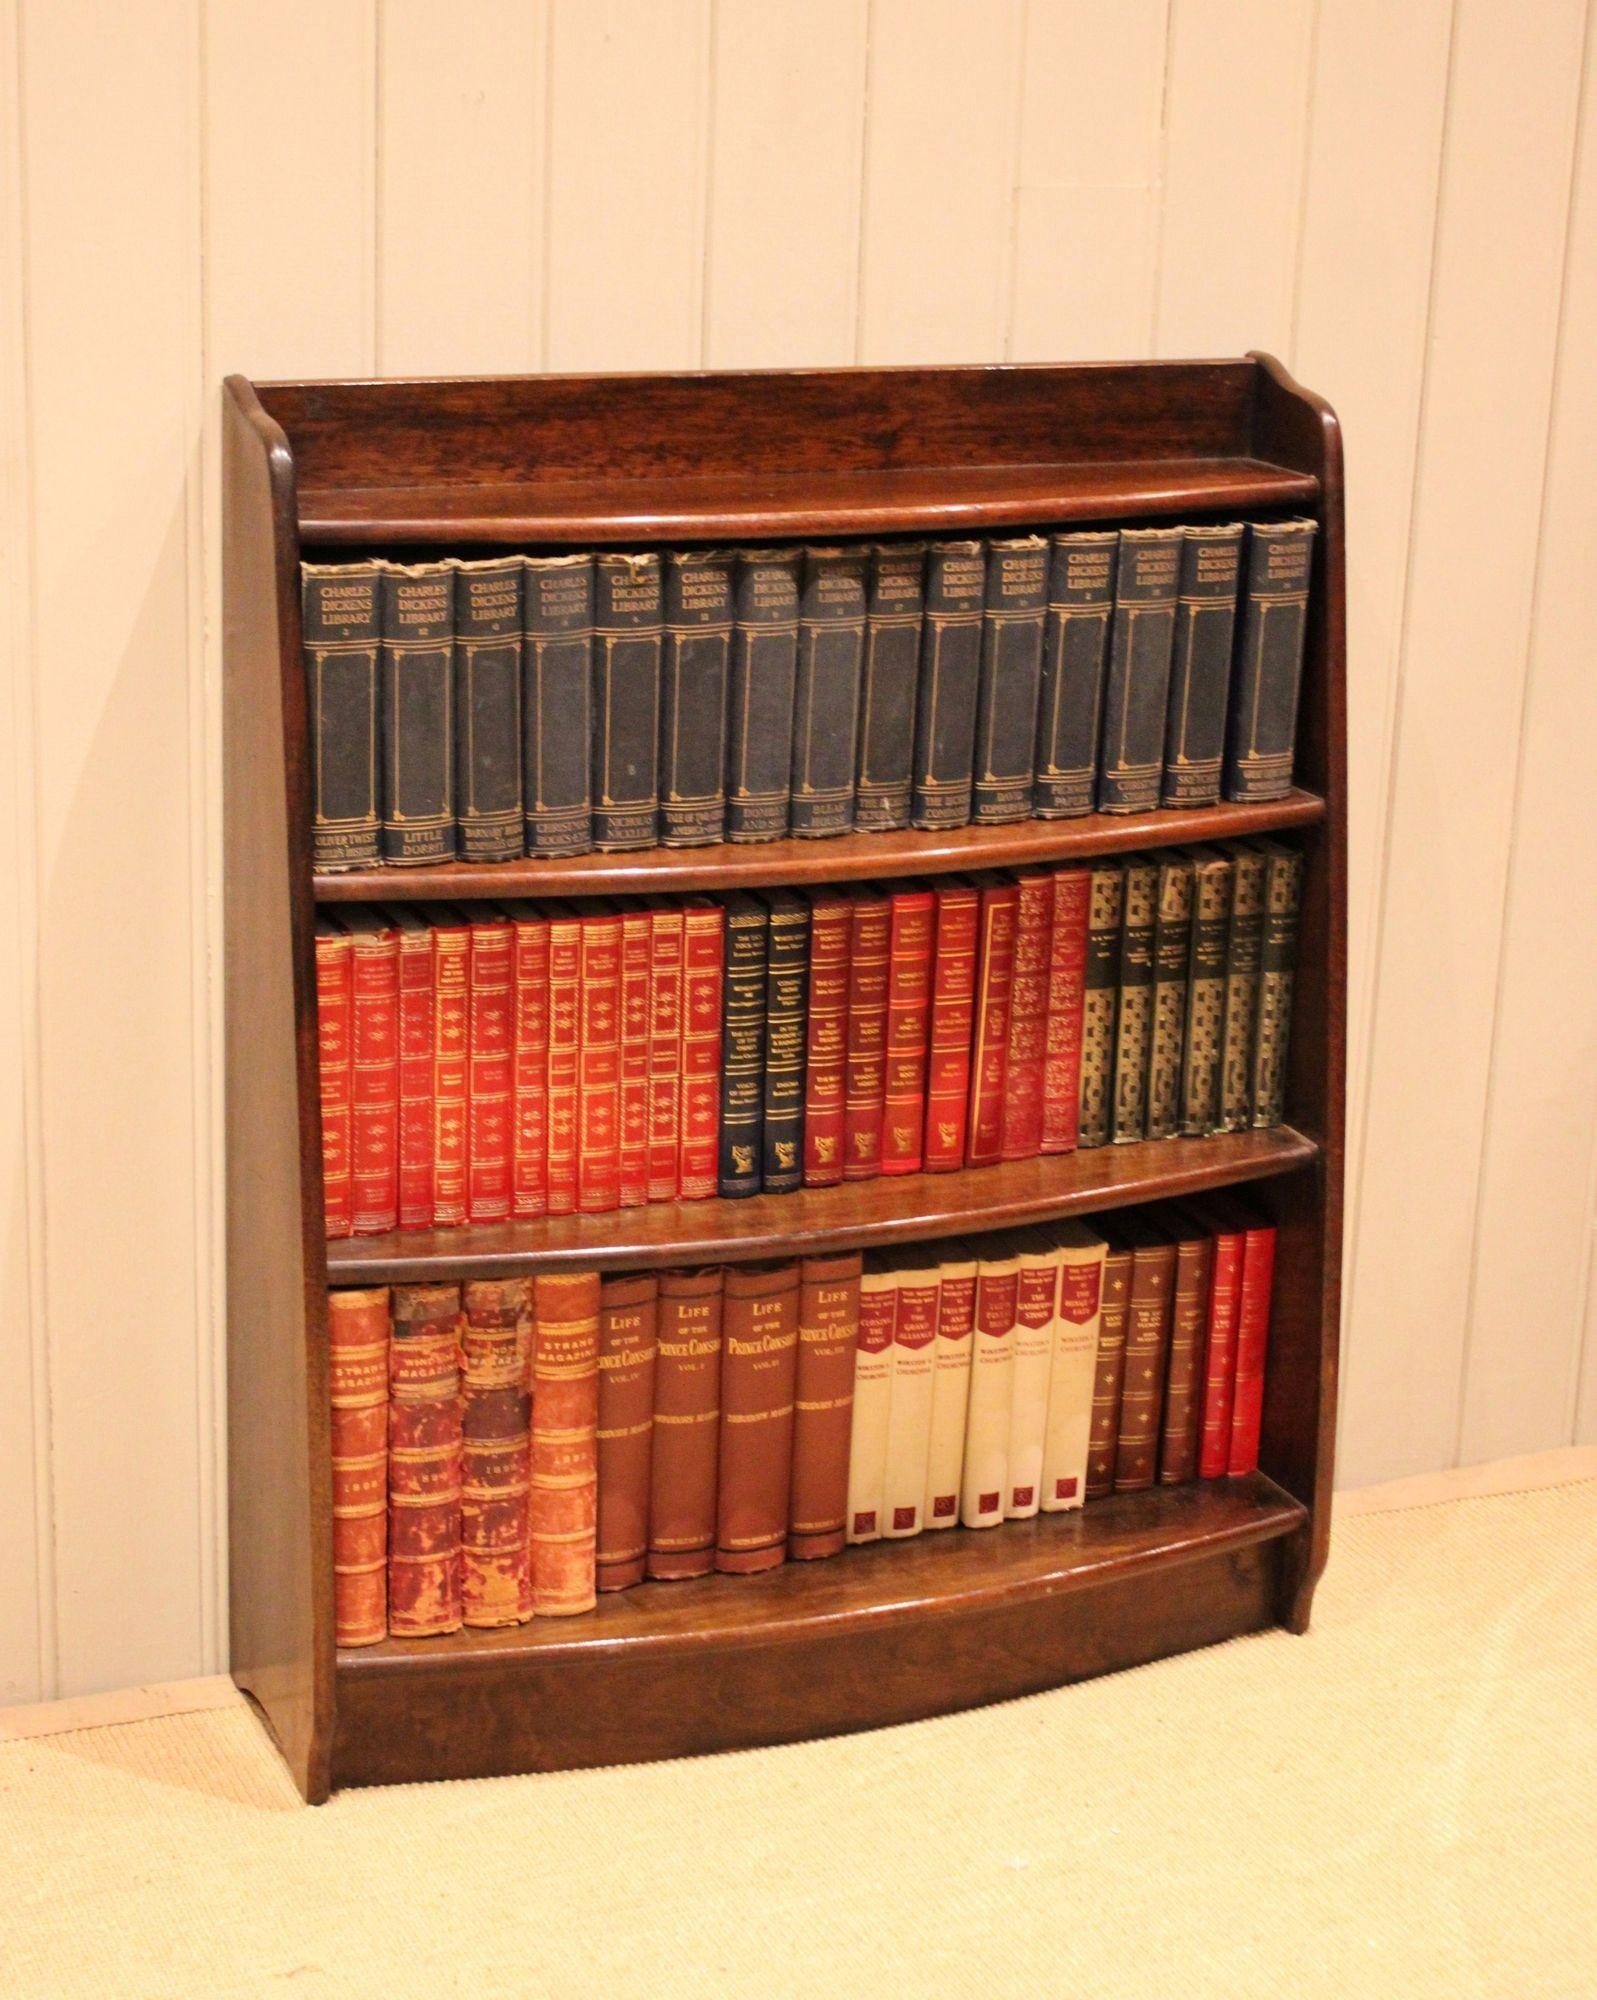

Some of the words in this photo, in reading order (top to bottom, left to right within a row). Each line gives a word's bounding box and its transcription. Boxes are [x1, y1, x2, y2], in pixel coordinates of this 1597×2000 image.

[1197, 546, 1237, 558] CHARLES
[1268, 543, 1307, 554] CHARLES
[1068, 553, 1111, 564] CHARLES
[1137, 550, 1176, 560] CHARLES
[1268, 555, 1307, 567] DICKENS
[880, 563, 921, 574] CHARLES
[943, 561, 984, 572] CHARLES
[1002, 558, 1044, 570] CHARLES
[1136, 561, 1176, 573] DICKENS
[1198, 558, 1237, 570] DICKENS
[682, 571, 728, 583] CHARLES
[1002, 571, 1045, 583] DICKENS
[1068, 565, 1110, 577] DICKENS
[1197, 570, 1236, 582] LIBRARY
[1268, 567, 1306, 579] LIBRARY
[540, 577, 587, 589] CHARLES
[819, 578, 861, 589] DICKENS
[879, 575, 921, 587] DICKENS
[943, 573, 984, 585] DICKENS
[1067, 577, 1108, 589] LIBRARY
[1136, 573, 1175, 585] LIBRARY
[321, 586, 372, 597] CHARLES
[398, 585, 447, 597] CHARLES
[470, 580, 517, 594] CHARLES
[612, 586, 659, 598] DICKENS
[682, 584, 728, 596] DICKENS
[754, 582, 797, 594] DICKENS
[943, 586, 983, 598] LIBRARY
[1002, 583, 1043, 595] LIBRARY
[541, 590, 587, 602] DICKENS
[819, 591, 861, 603] LIBRARY
[878, 587, 919, 600] LIBRARY
[321, 599, 372, 611] DICKENS
[398, 598, 447, 610] DICKENS
[471, 593, 517, 607] DICKENS
[612, 599, 658, 612] LIBRARY
[682, 597, 726, 609] LIBRARY
[755, 595, 796, 607] LIBRARY
[472, 606, 517, 620] LIBRARY
[542, 602, 587, 616] LIBRARY
[322, 613, 372, 625] LIBRARY
[399, 611, 446, 623] LIBRARY
[404, 830, 443, 842] LITTLE
[403, 842, 445, 855] DORRIT
[818, 1312, 828, 1320] OF
[830, 1309, 846, 1319] THE
[678, 1327, 689, 1335] OF
[691, 1326, 708, 1334] THE
[752, 1325, 763, 1333] OF
[764, 1321, 780, 1330] THE
[544, 1338, 594, 1350] STRAND
[624, 1336, 639, 1344] THE
[729, 1337, 762, 1355] PRINCE
[400, 1364, 456, 1377] MAGAZIN
